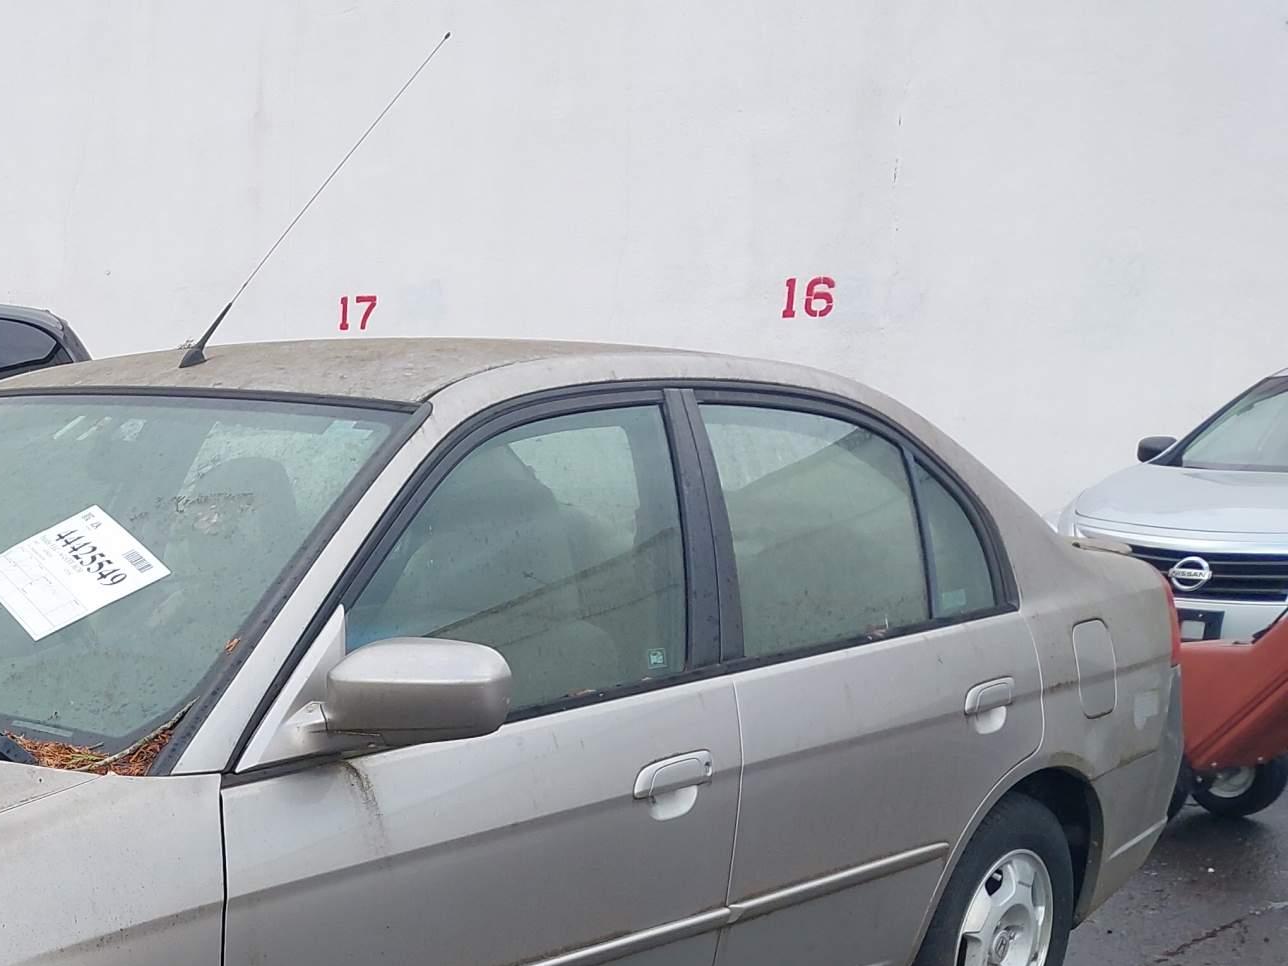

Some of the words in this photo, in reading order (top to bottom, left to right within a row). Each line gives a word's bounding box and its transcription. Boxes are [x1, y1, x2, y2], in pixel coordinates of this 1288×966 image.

[340, 295, 377, 331] 17
[782, 276, 835, 318] 16
[55, 529, 127, 586] 44425549
[1171, 569, 1207, 578] NISSAN
